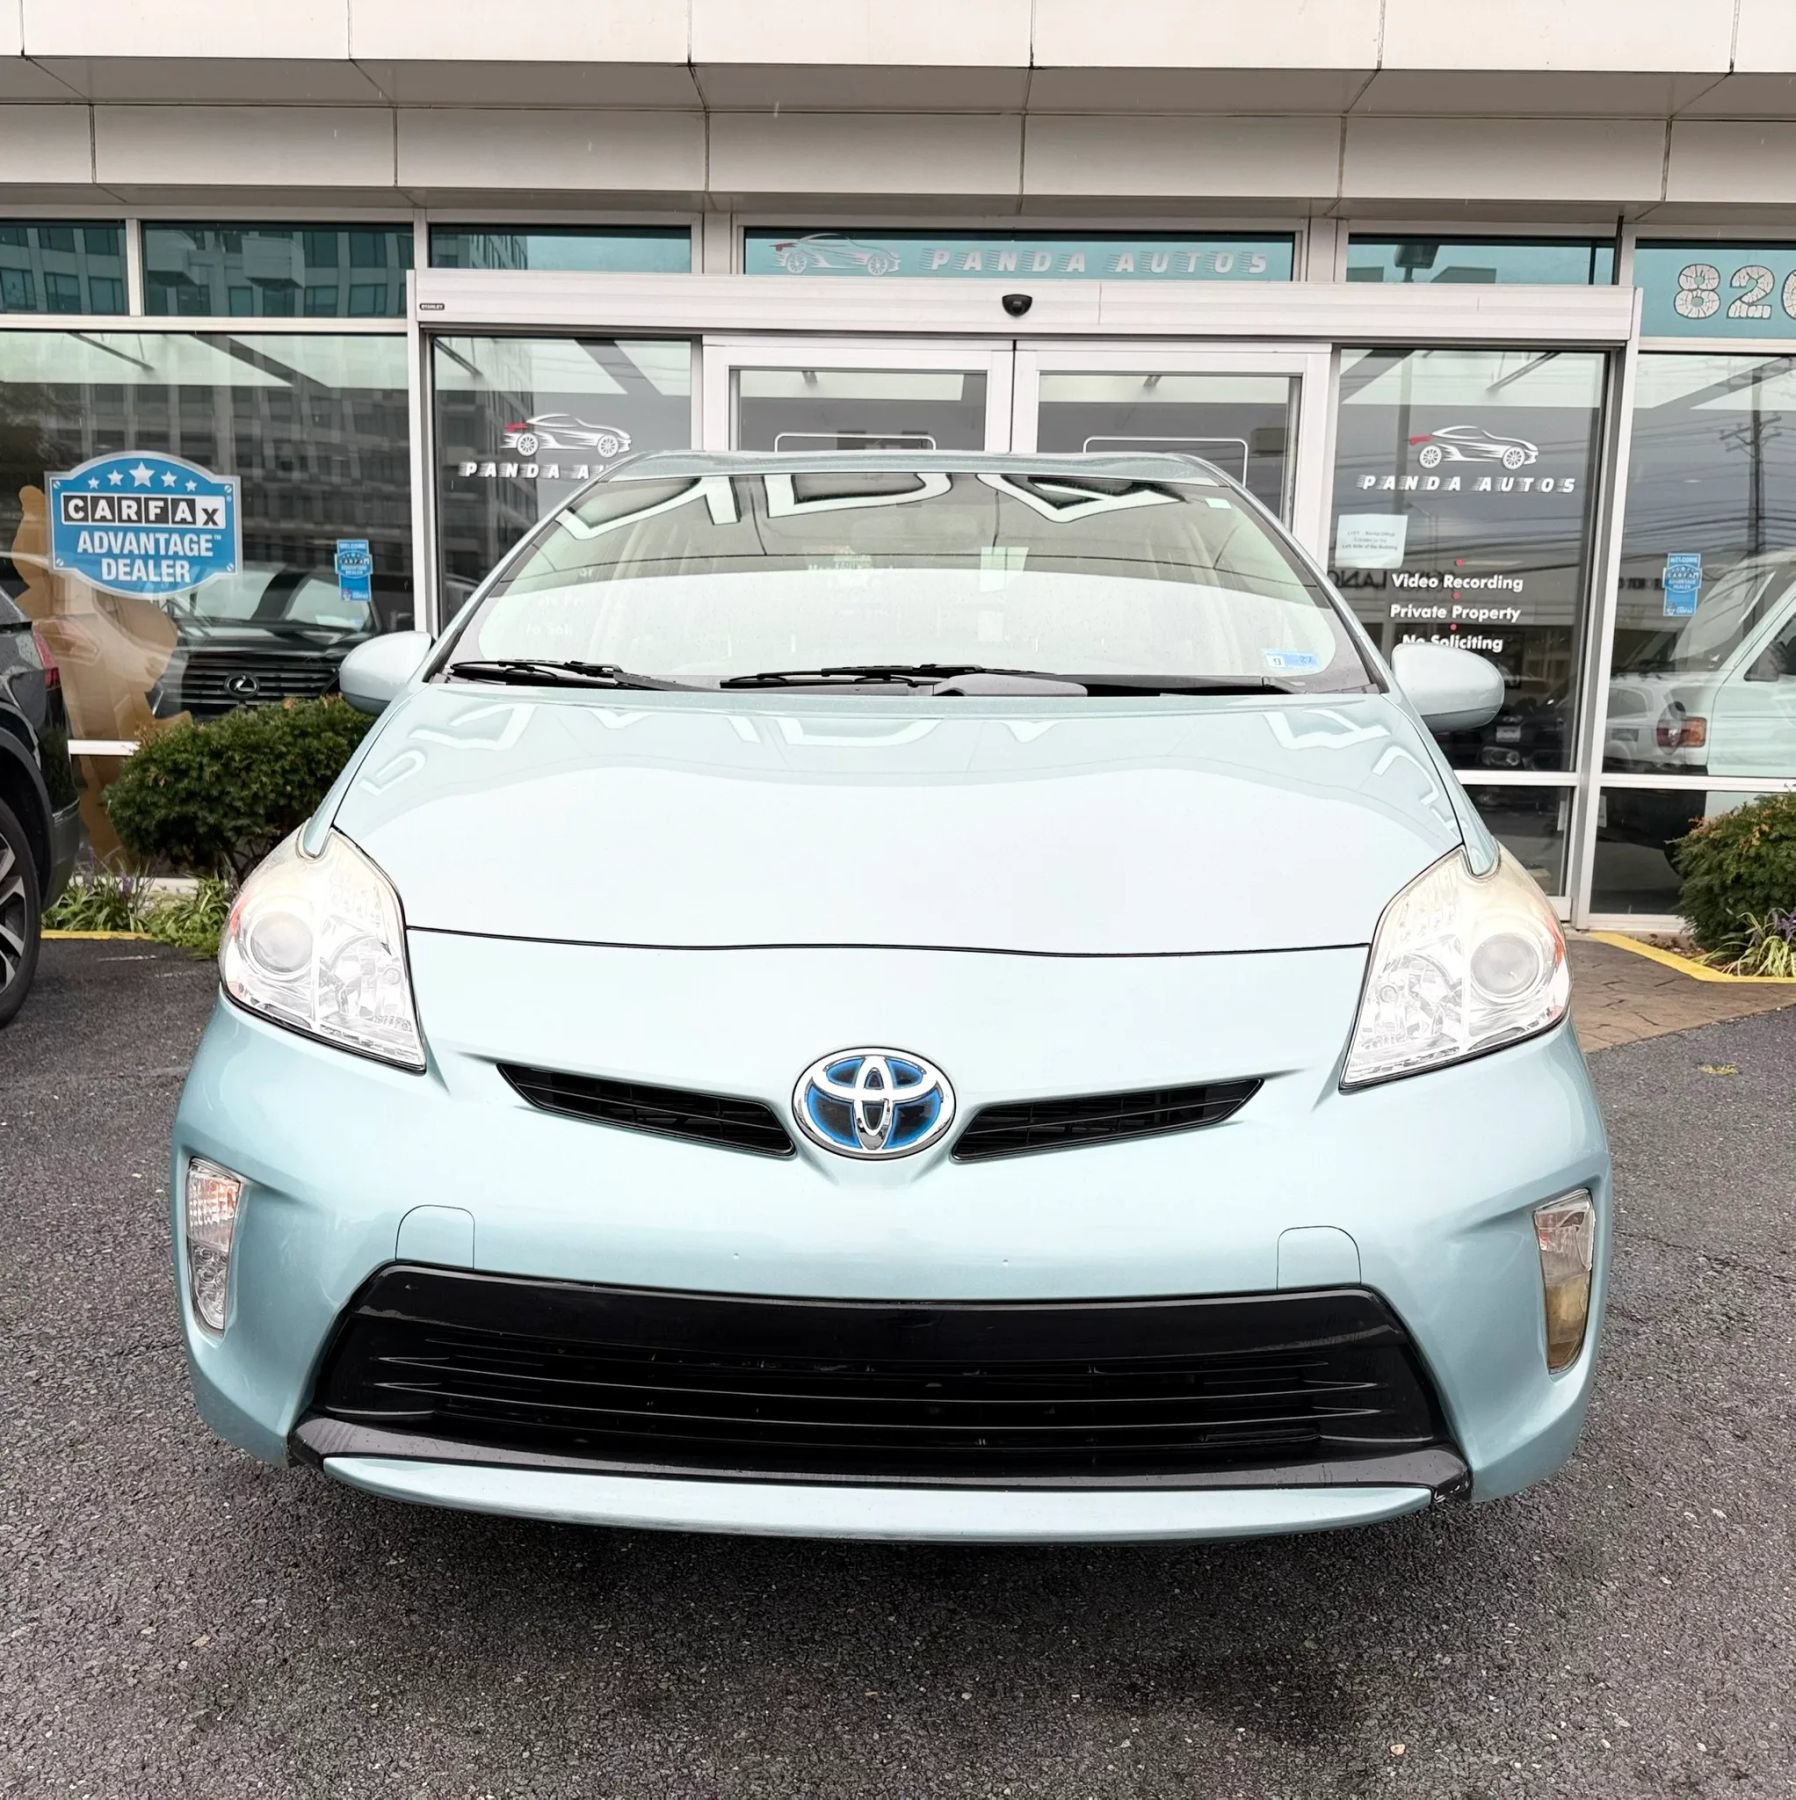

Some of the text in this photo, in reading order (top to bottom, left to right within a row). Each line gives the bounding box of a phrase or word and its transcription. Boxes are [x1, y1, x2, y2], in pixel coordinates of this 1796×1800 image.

[929, 248, 1268, 274] PANDA AUTOS
[464, 461, 560, 479] PANDA
[1361, 475, 1576, 493] PANDA AUTOS
[67, 497, 220, 527] CARFAX
[77, 530, 214, 557] ADVANTAGE
[101, 557, 191, 583] DEALER
[1392, 573, 1524, 592] Video Recording
[1390, 604, 1521, 623] Private Property
[1430, 634, 1504, 653] Soliciting
